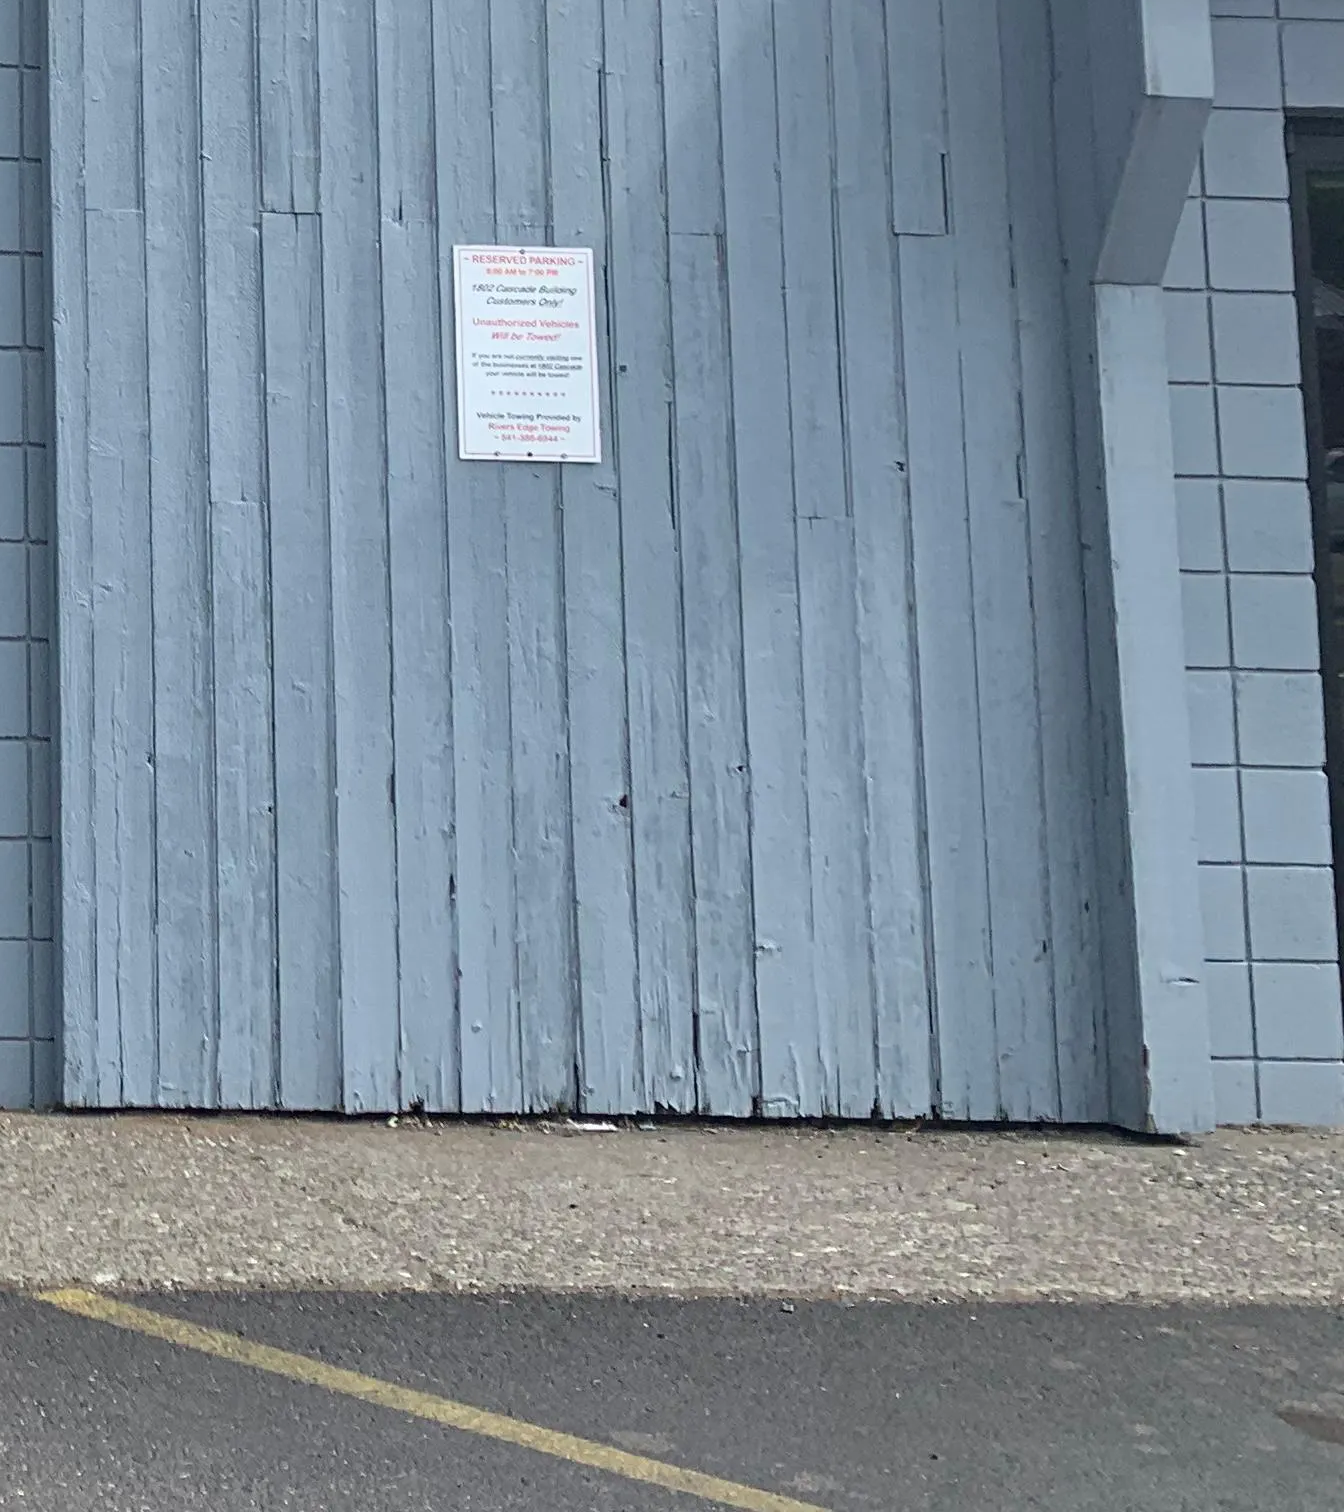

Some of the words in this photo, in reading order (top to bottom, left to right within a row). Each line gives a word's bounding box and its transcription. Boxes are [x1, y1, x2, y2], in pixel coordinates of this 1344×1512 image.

[472, 254, 527, 265] RESERVED
[529, 256, 576, 266] PARKING
[496, 284, 536, 293] Cascade
[538, 285, 577, 296] Building
[486, 296, 536, 306] Customers
[472, 318, 537, 328] Unauthorized
[539, 320, 579, 329] Vehicles
[492, 332, 509, 340] Will
[510, 332, 524, 340] be
[506, 412, 534, 421] Towing
[536, 413, 570, 421] Provided
[540, 423, 570, 433] Towing
